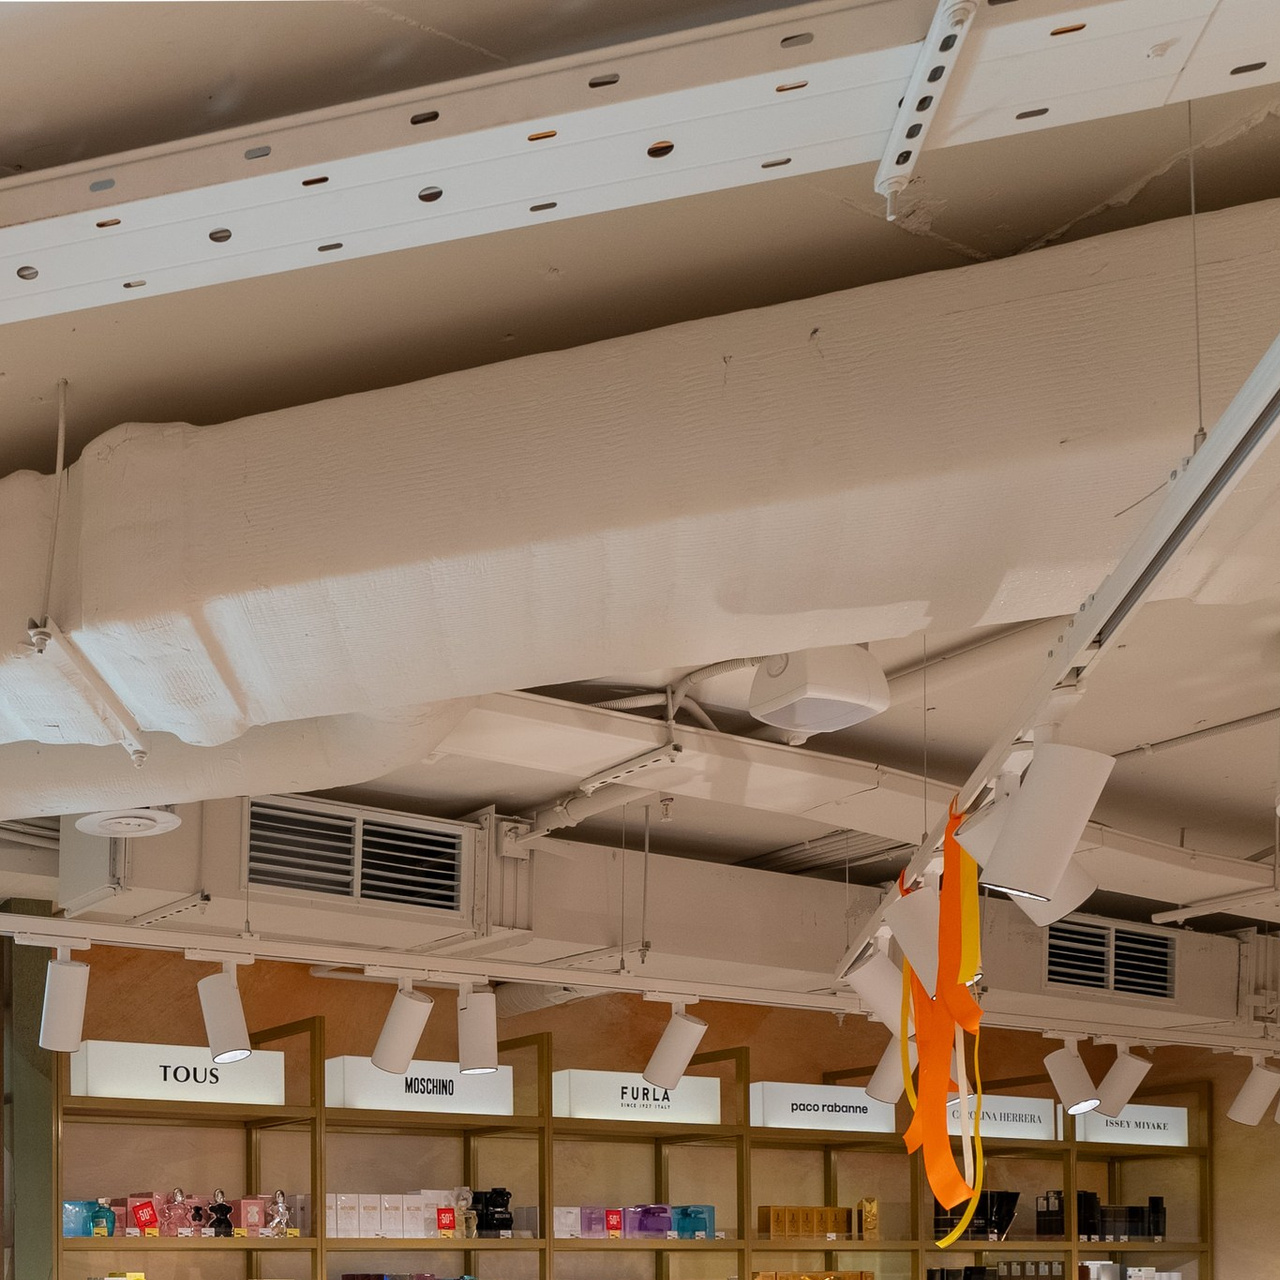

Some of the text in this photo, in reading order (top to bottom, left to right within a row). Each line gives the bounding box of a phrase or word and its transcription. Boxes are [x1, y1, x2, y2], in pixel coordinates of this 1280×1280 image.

[159, 1064, 219, 1084] TOUS
[404, 1076, 454, 1096] MOSCHINO
[621, 1085, 670, 1102] FURLA
[791, 1102, 869, 1114] paco rabanne
[999, 1111, 1042, 1124] HERRERA
[1105, 1119, 1169, 1131] ISSEY MIYAKE
